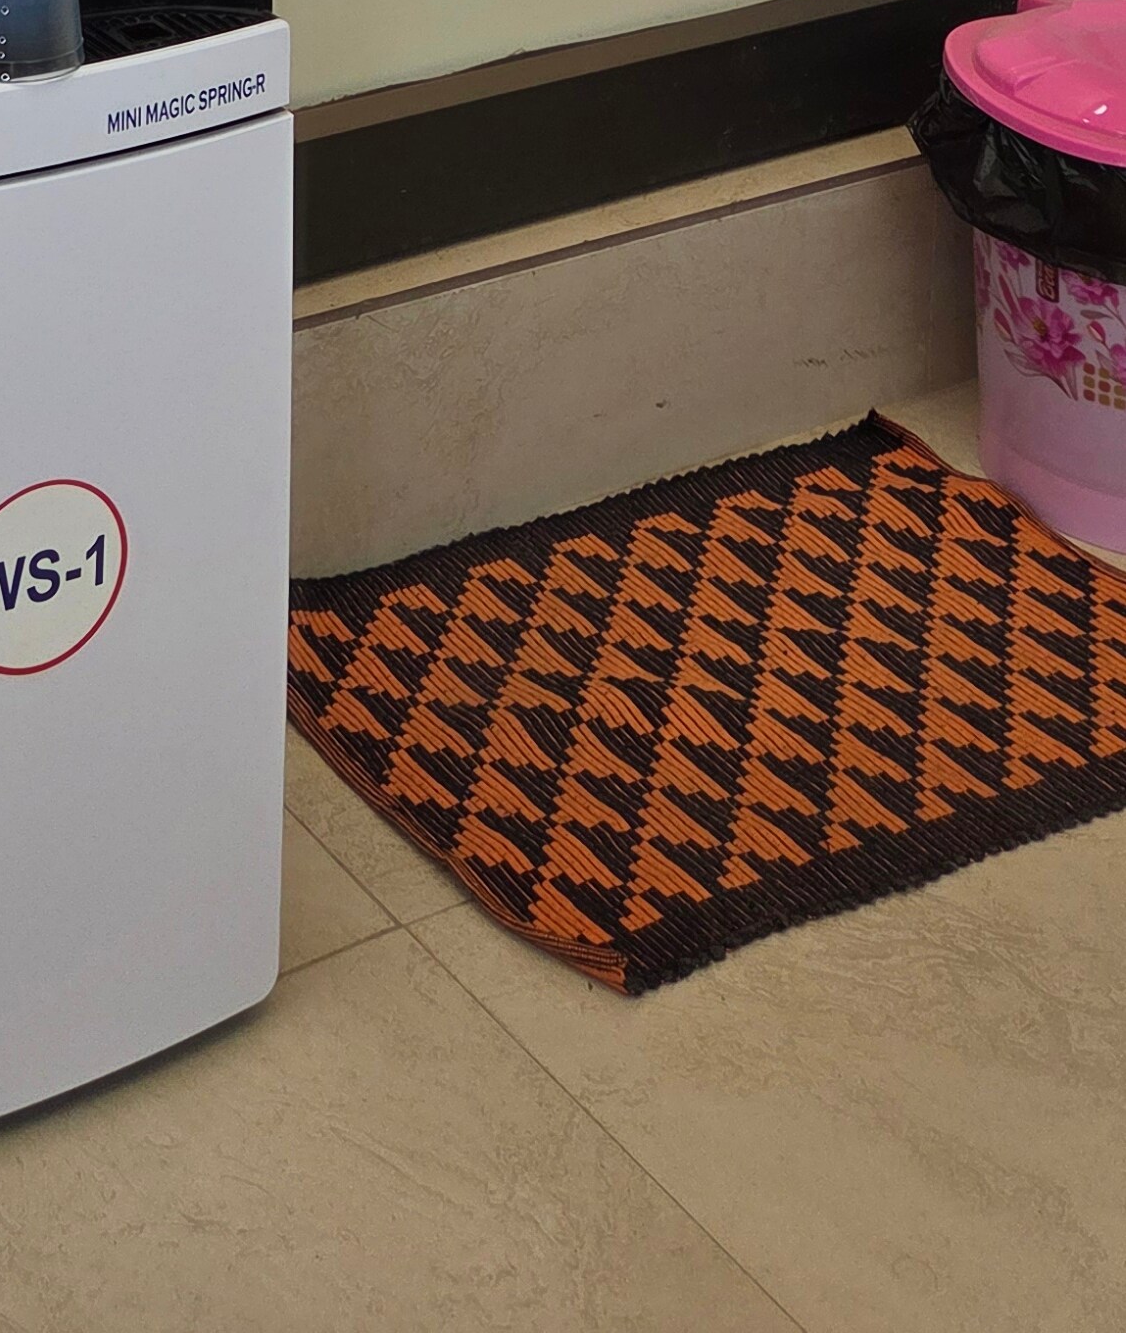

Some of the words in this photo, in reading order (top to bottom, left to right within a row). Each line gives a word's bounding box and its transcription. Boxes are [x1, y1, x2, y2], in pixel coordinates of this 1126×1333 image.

[108, 107, 141, 134] MINI
[146, 94, 195, 125] MAGIC
[199, 73, 265, 110] SPRING-R
